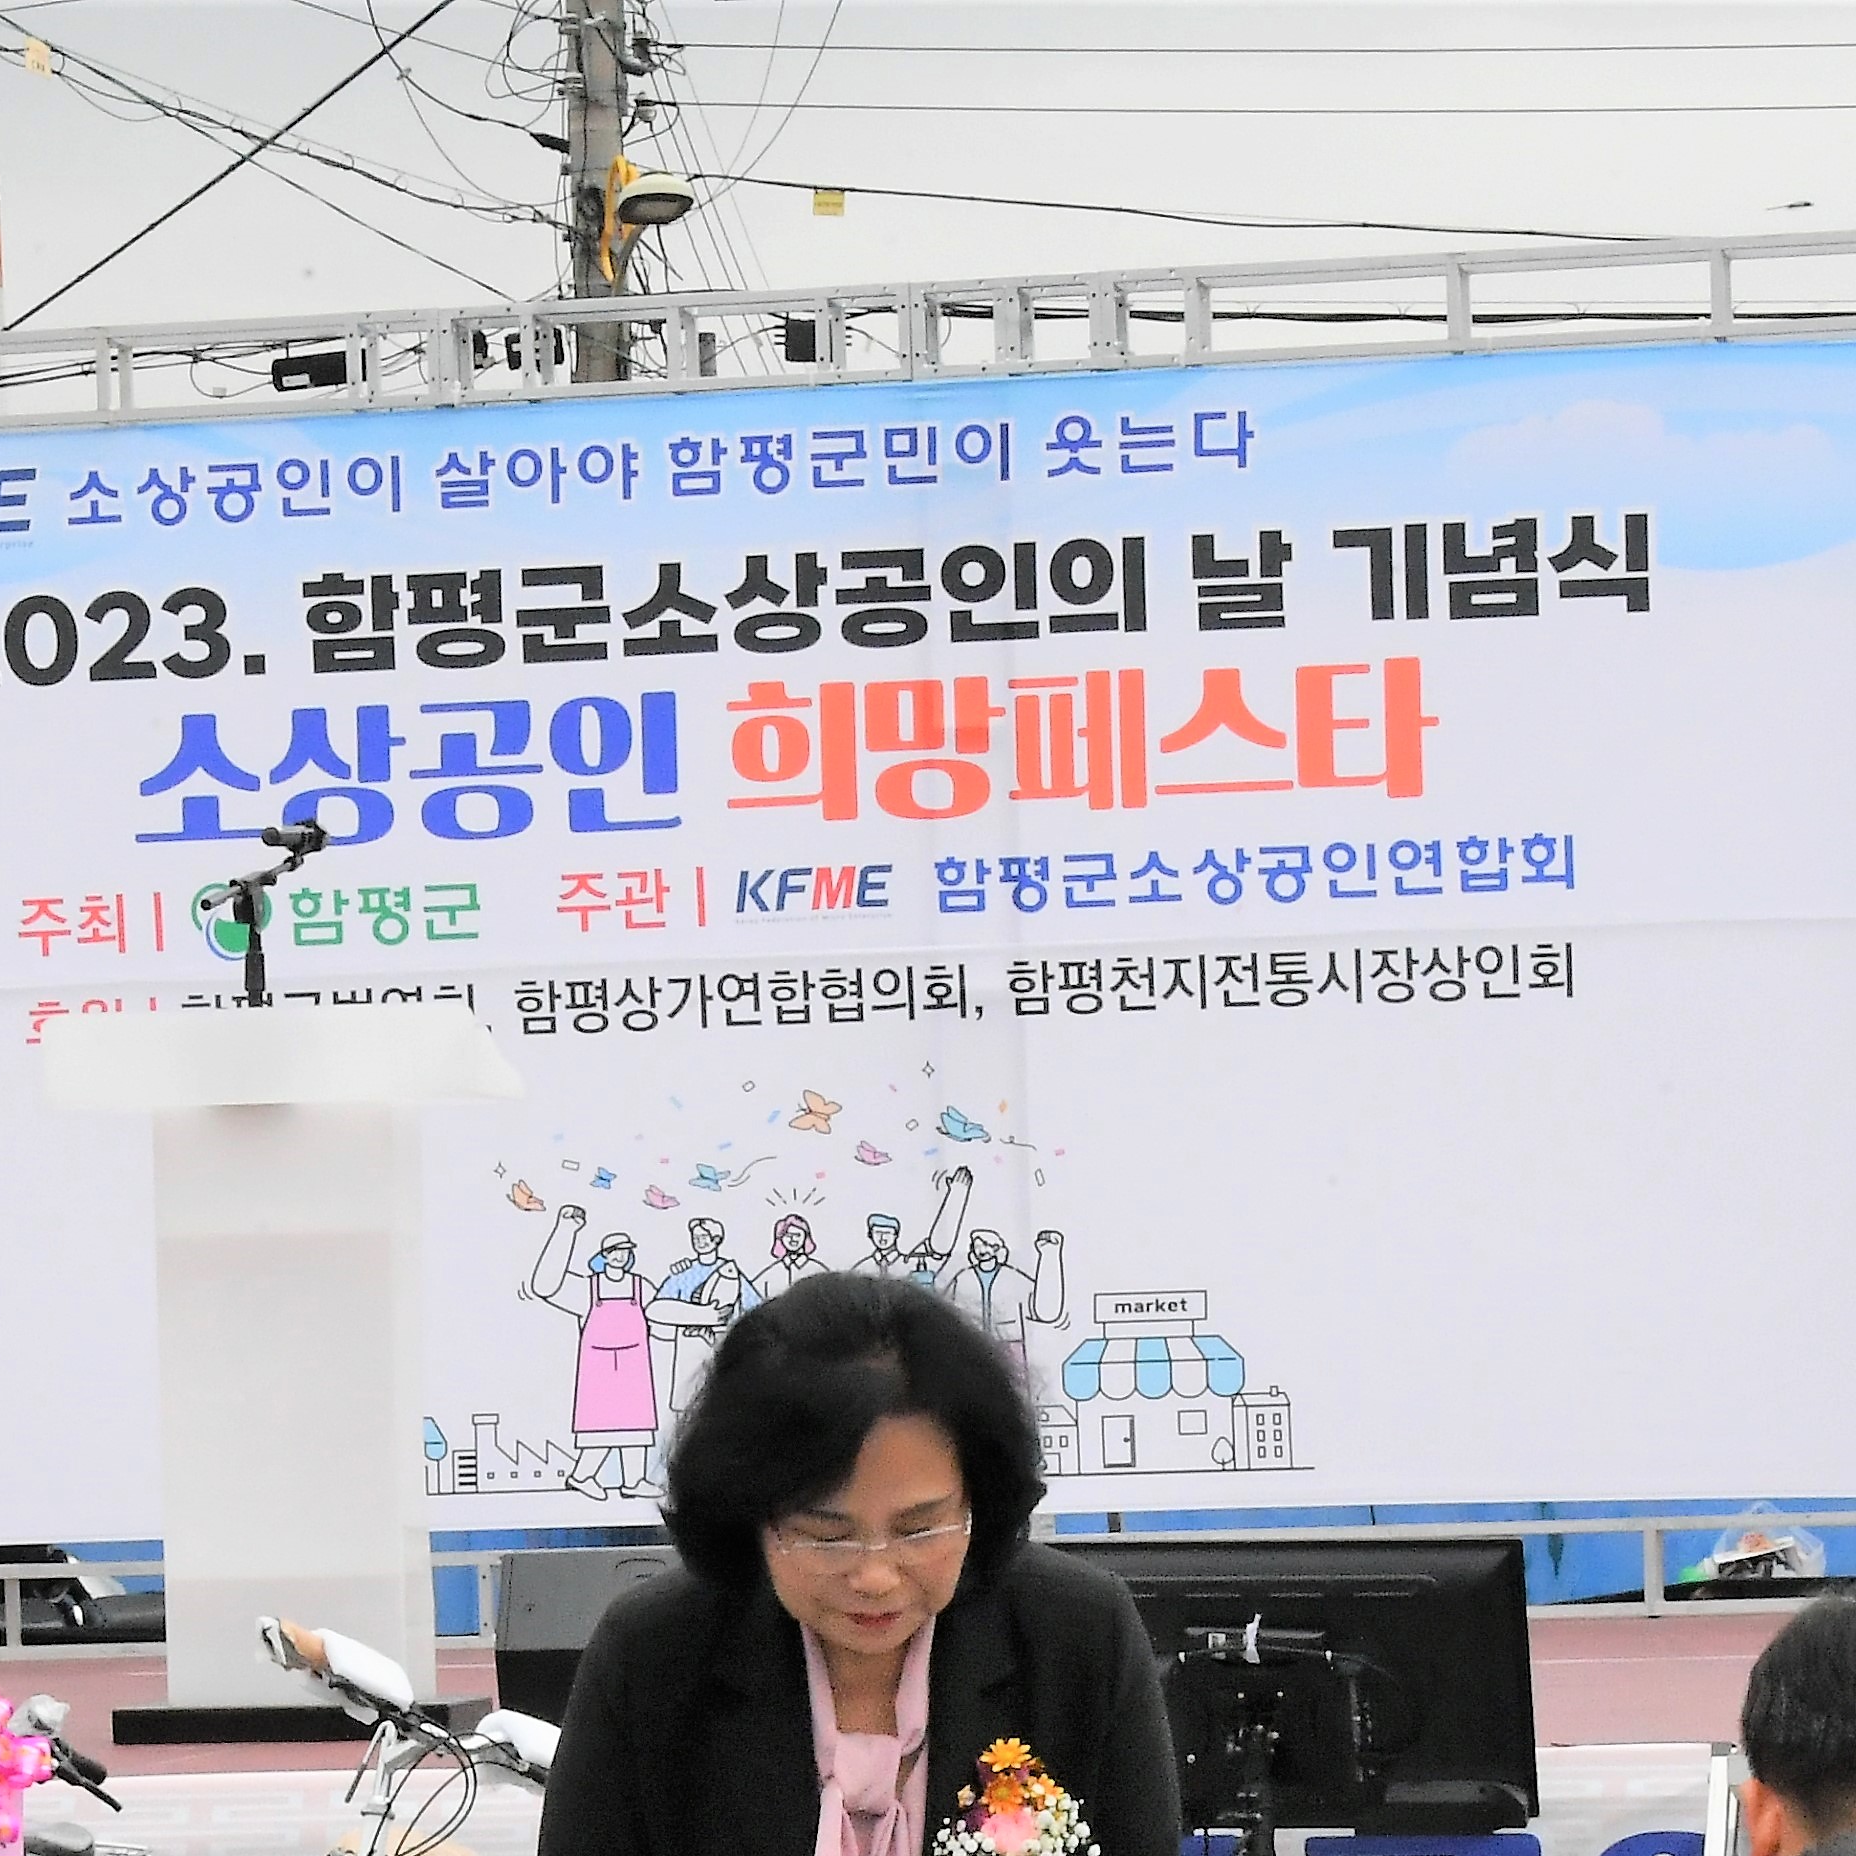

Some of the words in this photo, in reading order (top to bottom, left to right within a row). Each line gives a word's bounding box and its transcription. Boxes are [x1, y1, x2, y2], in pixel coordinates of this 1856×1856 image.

[67, 455, 403, 528] 소상공인이
[435, 442, 639, 511] 살아야
[668, 421, 1011, 497] 함평군민이
[1046, 410, 1256, 479] 웃는다
[302, 535, 1149, 674] 함평군소상공인의
[1191, 530, 1292, 632] 날
[1333, 513, 1650, 620] 기념식
[135, 691, 682, 846] 소상공인
[726, 656, 1440, 822] 희망페스타
[18, 895, 126, 957] 주최
[291, 884, 481, 947] 함평군
[556, 870, 670, 932] 주관
[736, 864, 892, 913] KFME
[933, 832, 1577, 916] 함평군소상공인연합회
[514, 965, 986, 1035] 함평상가연합협의회,
[1006, 942, 1577, 1018] 함평천지전통시장상인회
[1114, 1298, 1188, 1314] market
